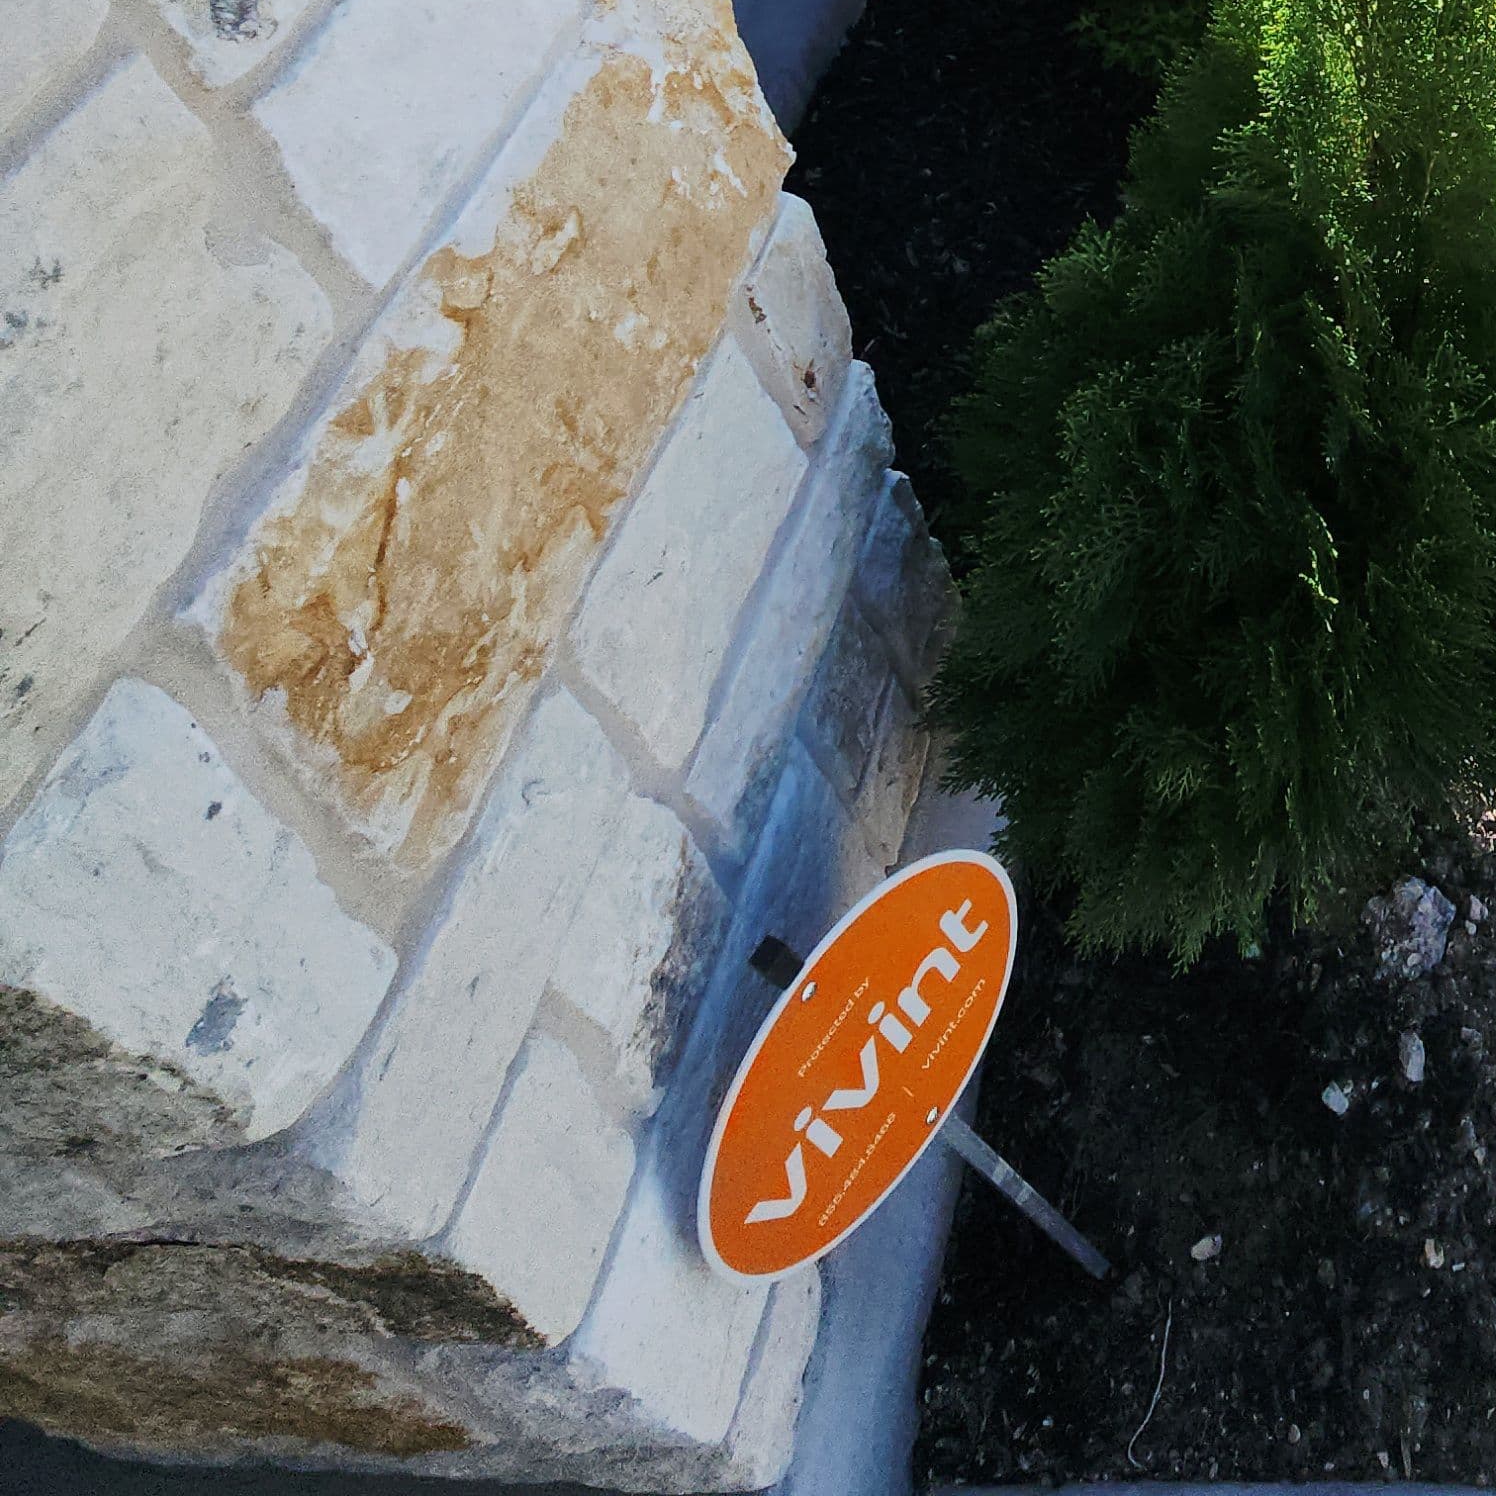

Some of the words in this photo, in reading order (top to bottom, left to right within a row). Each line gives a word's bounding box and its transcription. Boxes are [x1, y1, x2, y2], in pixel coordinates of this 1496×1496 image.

[744, 899, 988, 1224] vivint
[798, 998, 854, 1077] Protected
[854, 977, 870, 999] by
[921, 979, 986, 1070] vivint.com
